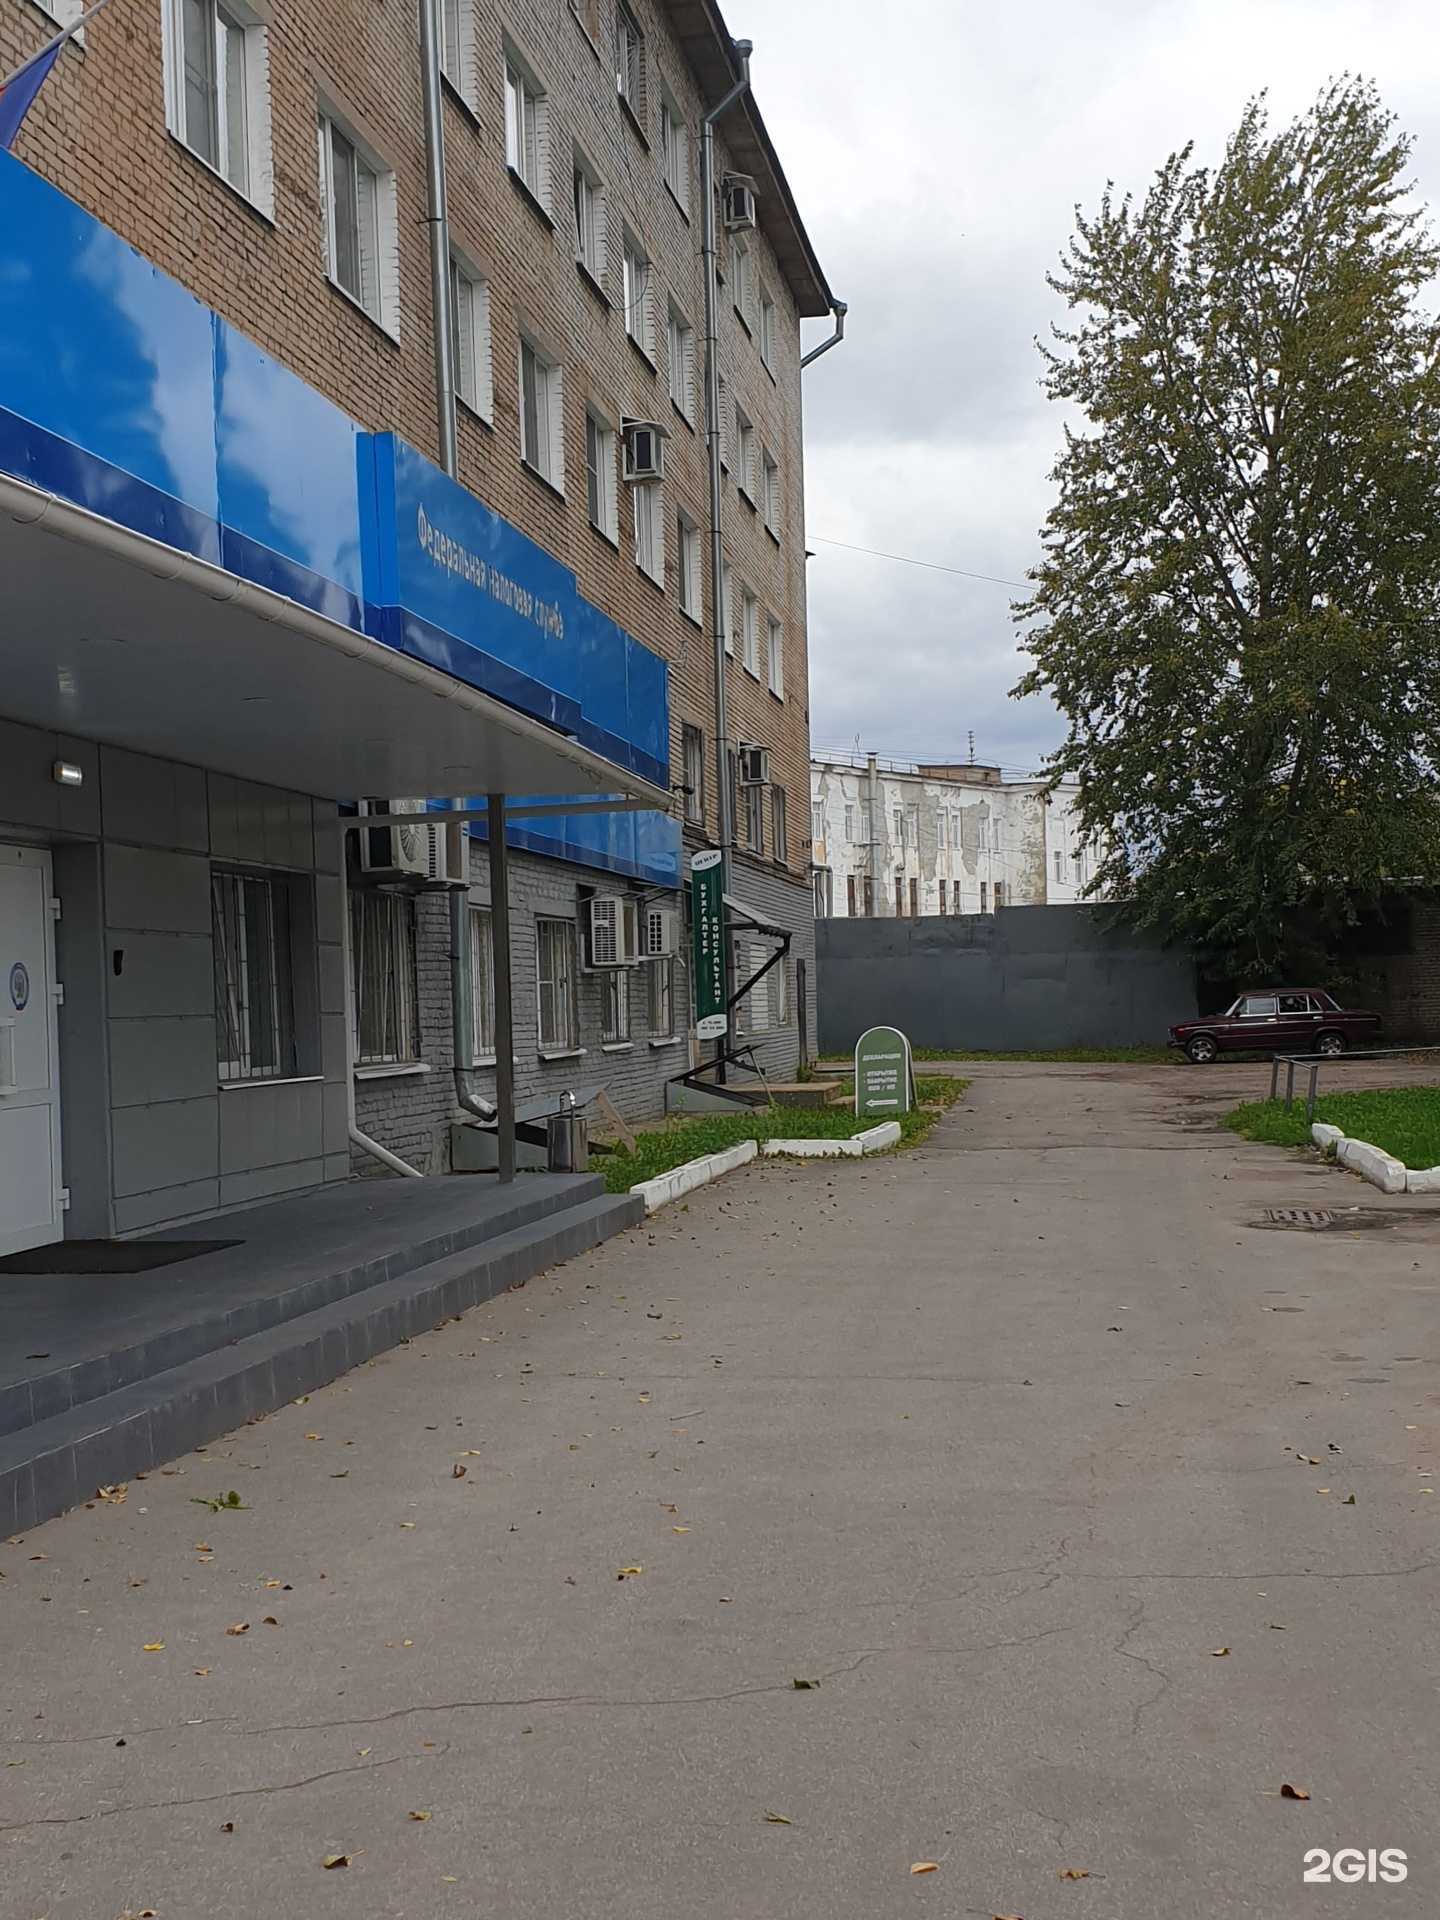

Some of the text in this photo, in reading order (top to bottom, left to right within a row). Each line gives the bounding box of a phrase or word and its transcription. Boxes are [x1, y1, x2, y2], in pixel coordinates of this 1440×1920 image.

[417, 502, 564, 640] Федеральная налоговая служба
[700, 883, 709, 955] БУХГАЛТЕР
[712, 916, 721, 1004] КОНСУЛЬТАНТ
